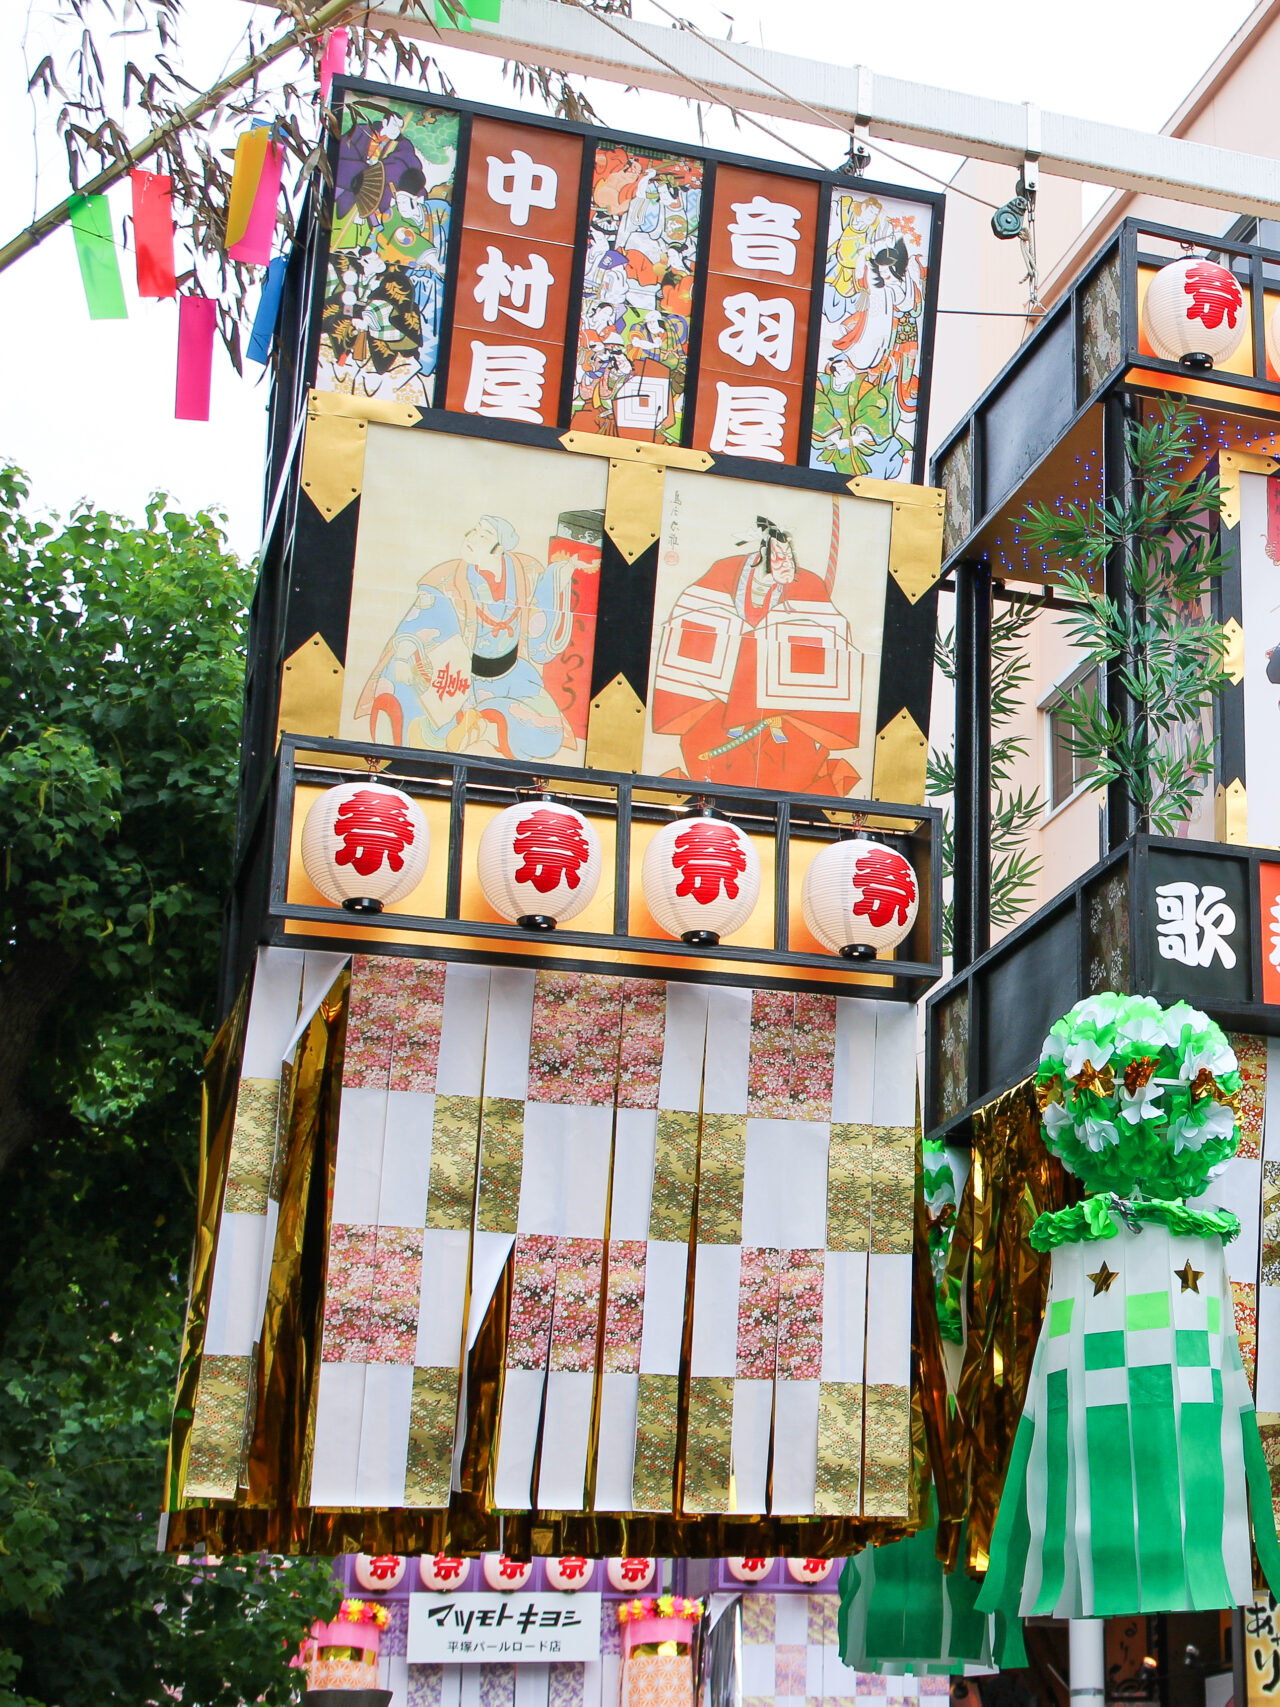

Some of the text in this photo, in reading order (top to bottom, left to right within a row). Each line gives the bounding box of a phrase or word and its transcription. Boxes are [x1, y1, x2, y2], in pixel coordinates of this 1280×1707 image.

[463, 149, 557, 424] 中村屋
[1184, 263, 1242, 329] 祭
[709, 195, 801, 462] 音羽屋
[335, 790, 415, 876] 祭
[514, 809, 589, 893] 祭
[672, 823, 746, 905] 祭
[853, 848, 916, 928] 祭
[428, 1602, 582, 1635] マツモトキヨシ
